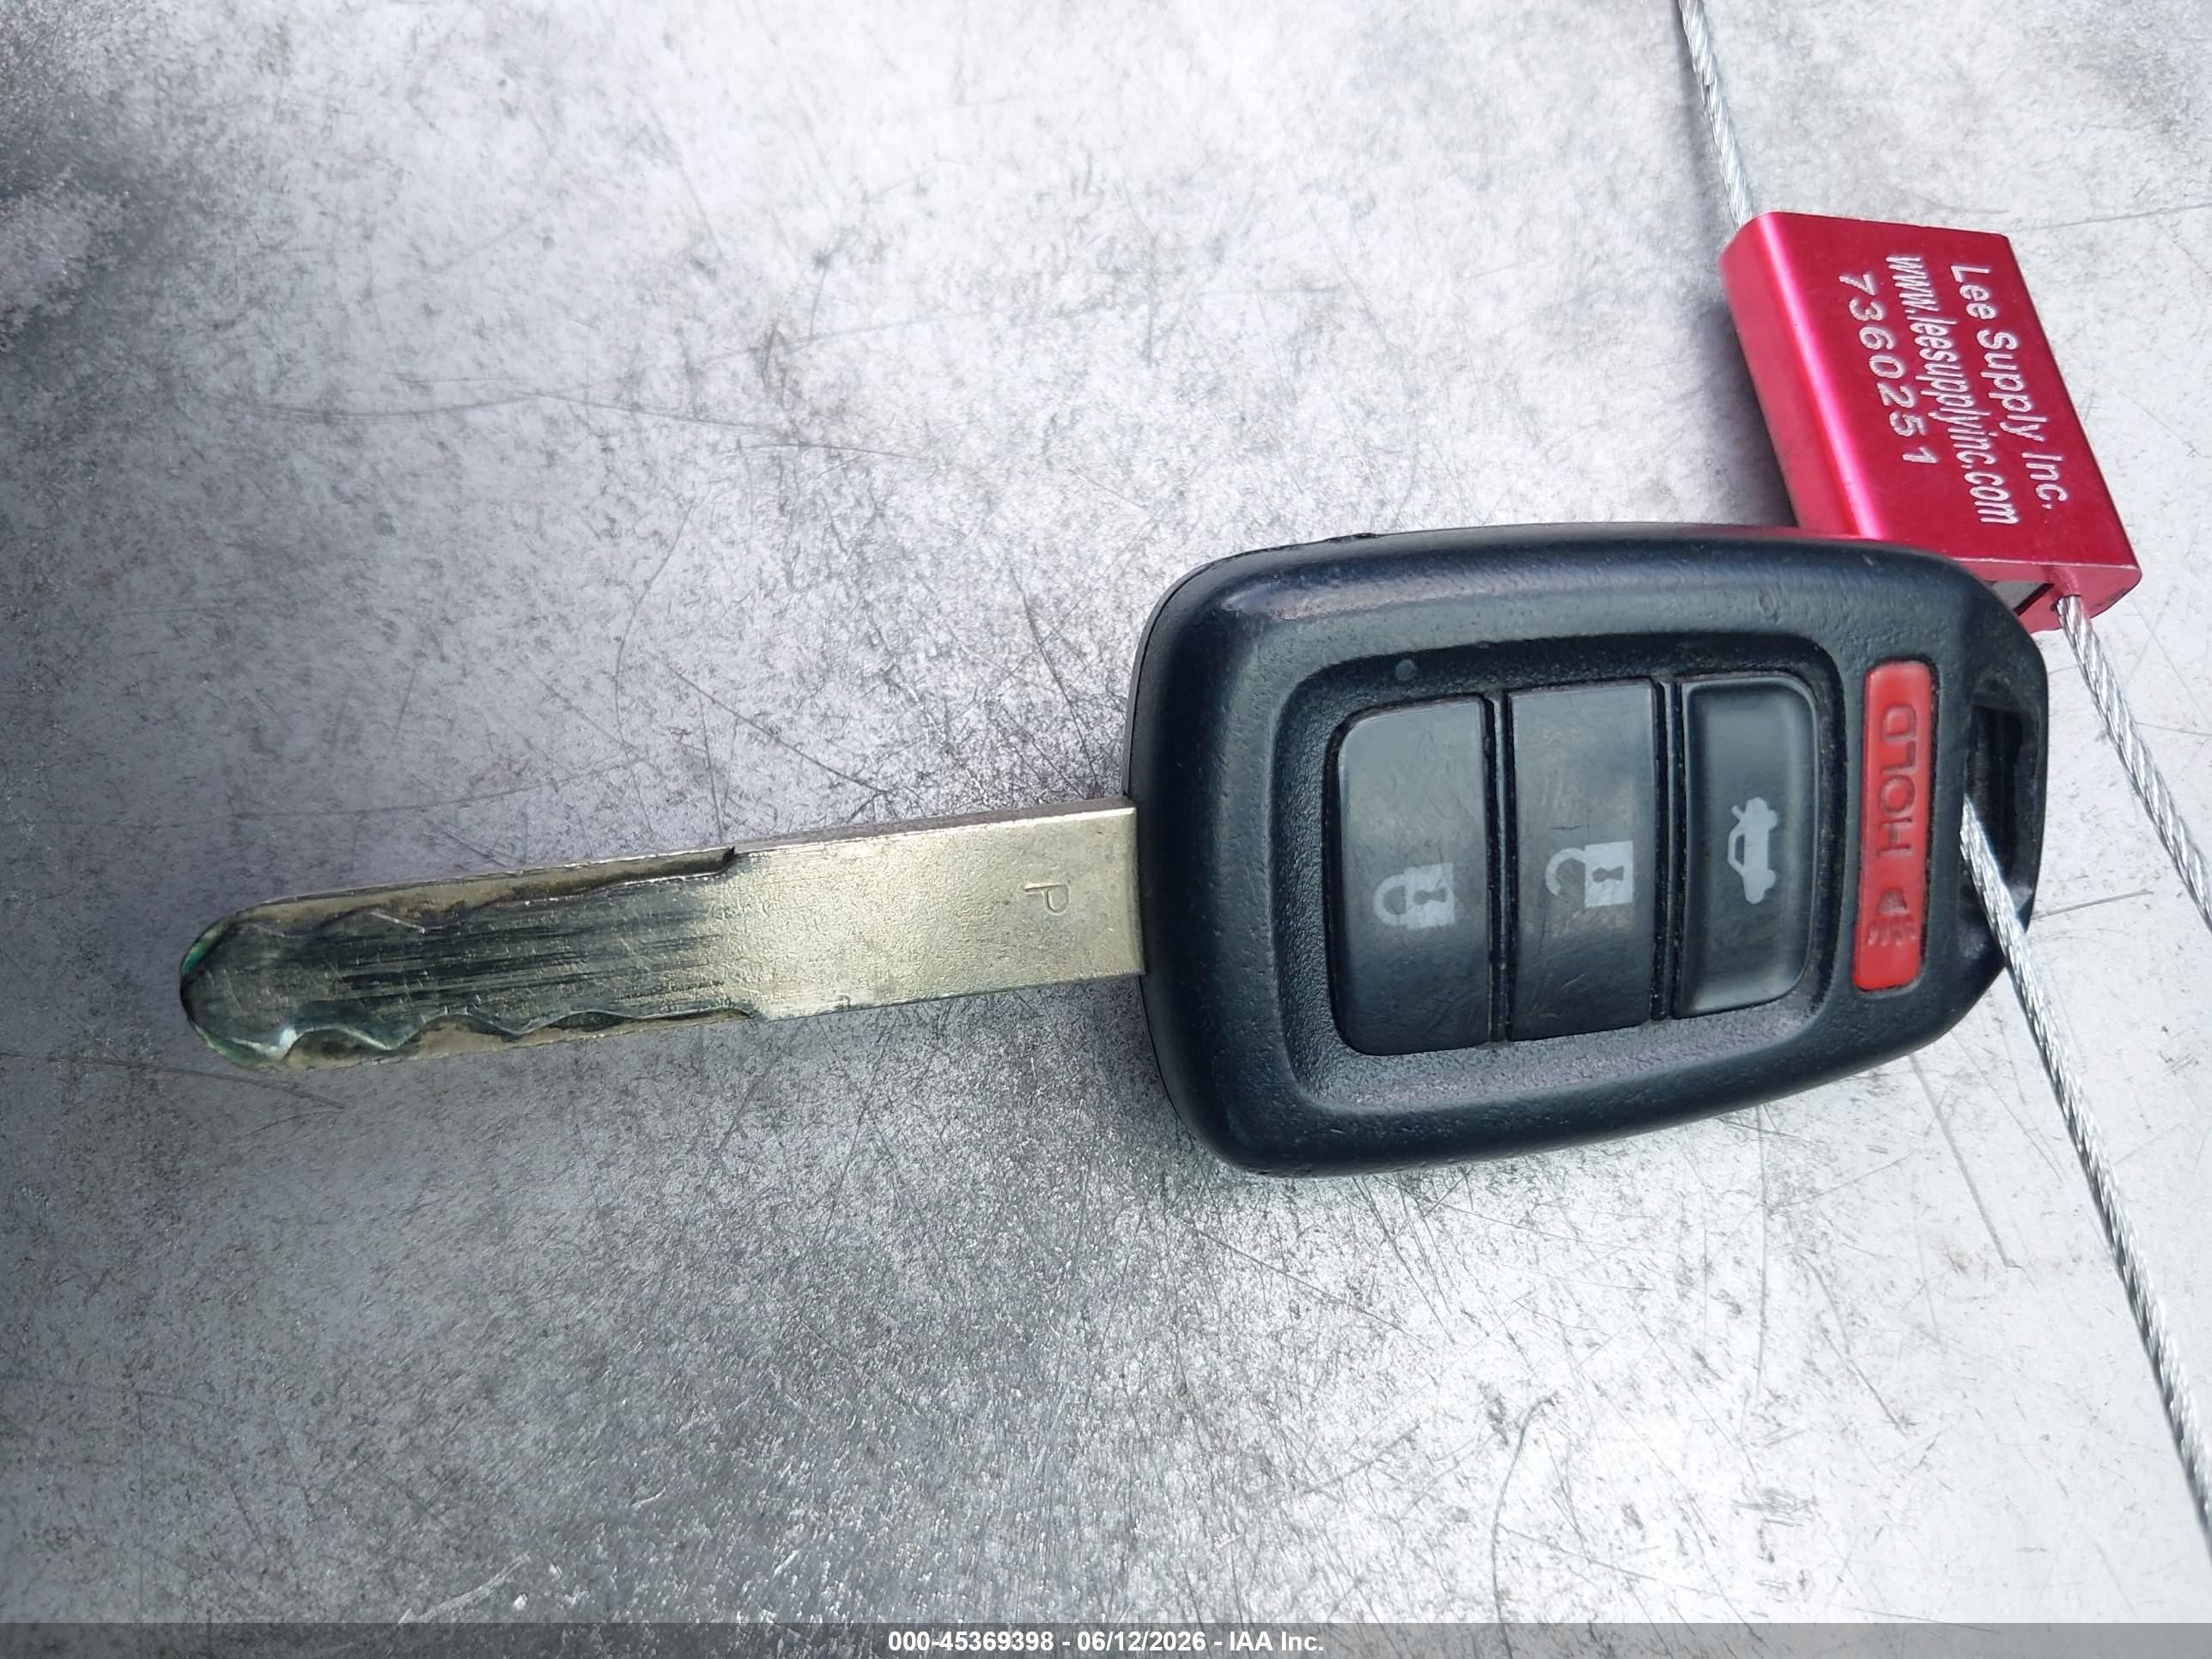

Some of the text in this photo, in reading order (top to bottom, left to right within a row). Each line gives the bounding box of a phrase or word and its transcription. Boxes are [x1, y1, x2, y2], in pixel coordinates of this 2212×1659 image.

[1838, 271, 1939, 465] 7360251
[1886, 254, 2020, 526] www.leesupplyinc.com
[1951, 263, 2068, 510] Lee Supply Inc.
[1876, 704, 1917, 858] HOLD
[1024, 883, 1069, 915] P
